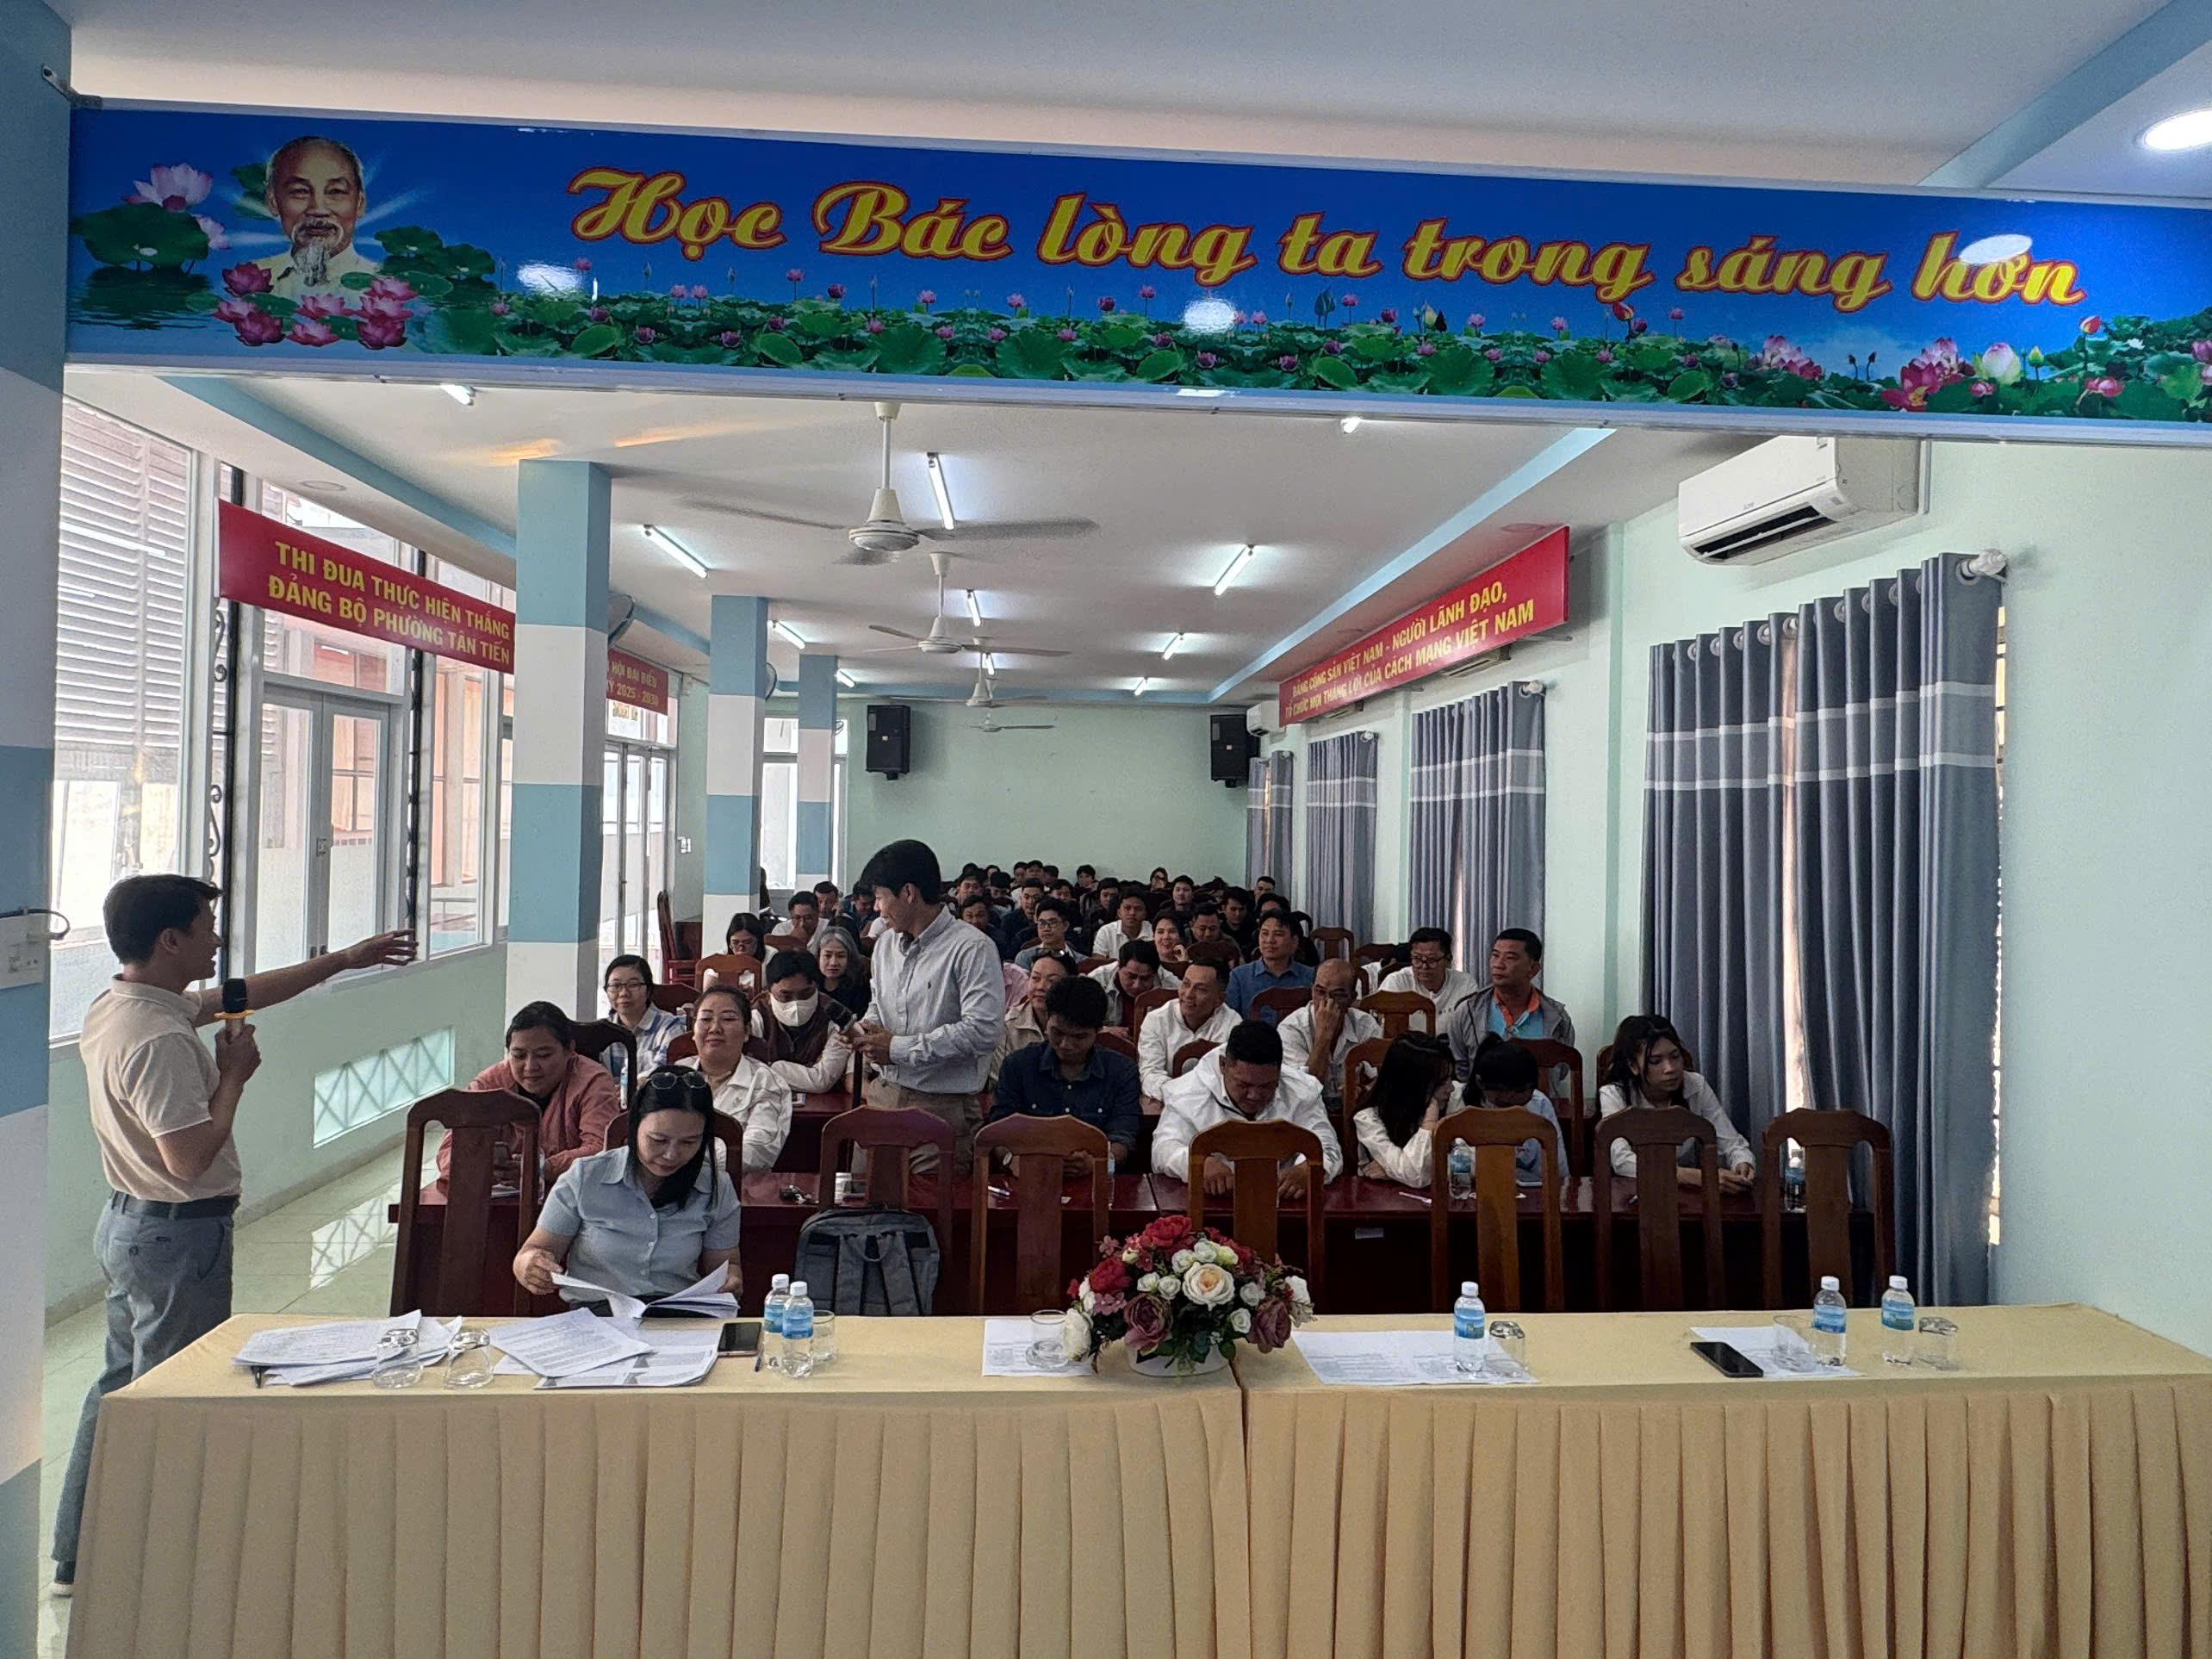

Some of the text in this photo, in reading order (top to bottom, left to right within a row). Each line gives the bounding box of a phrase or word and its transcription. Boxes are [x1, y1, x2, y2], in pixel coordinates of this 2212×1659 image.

[567, 167, 2088, 313] Học Bác lòng ta trong sáng hơn
[269, 573, 510, 665] ĐẢNG BỘ PHƯỜNG TÂN TIẾN
[276, 541, 510, 641] THI ĐUA THỰC HIỆN THẮNG
[1343, 652, 1361, 675] VIỆT
[1364, 642, 1383, 665] NAM
[1392, 618, 1426, 651] NGƯỜI
[1430, 599, 1465, 634] LÃNH
[1469, 581, 1507, 613] ĐẠO,
[1364, 663, 1382, 687] CỦA
[1384, 653, 1412, 680] CÁCH
[1415, 636, 1452, 667] MẠNG
[1455, 618, 1489, 650] VIỆT
[1494, 599, 1534, 636] NAM
